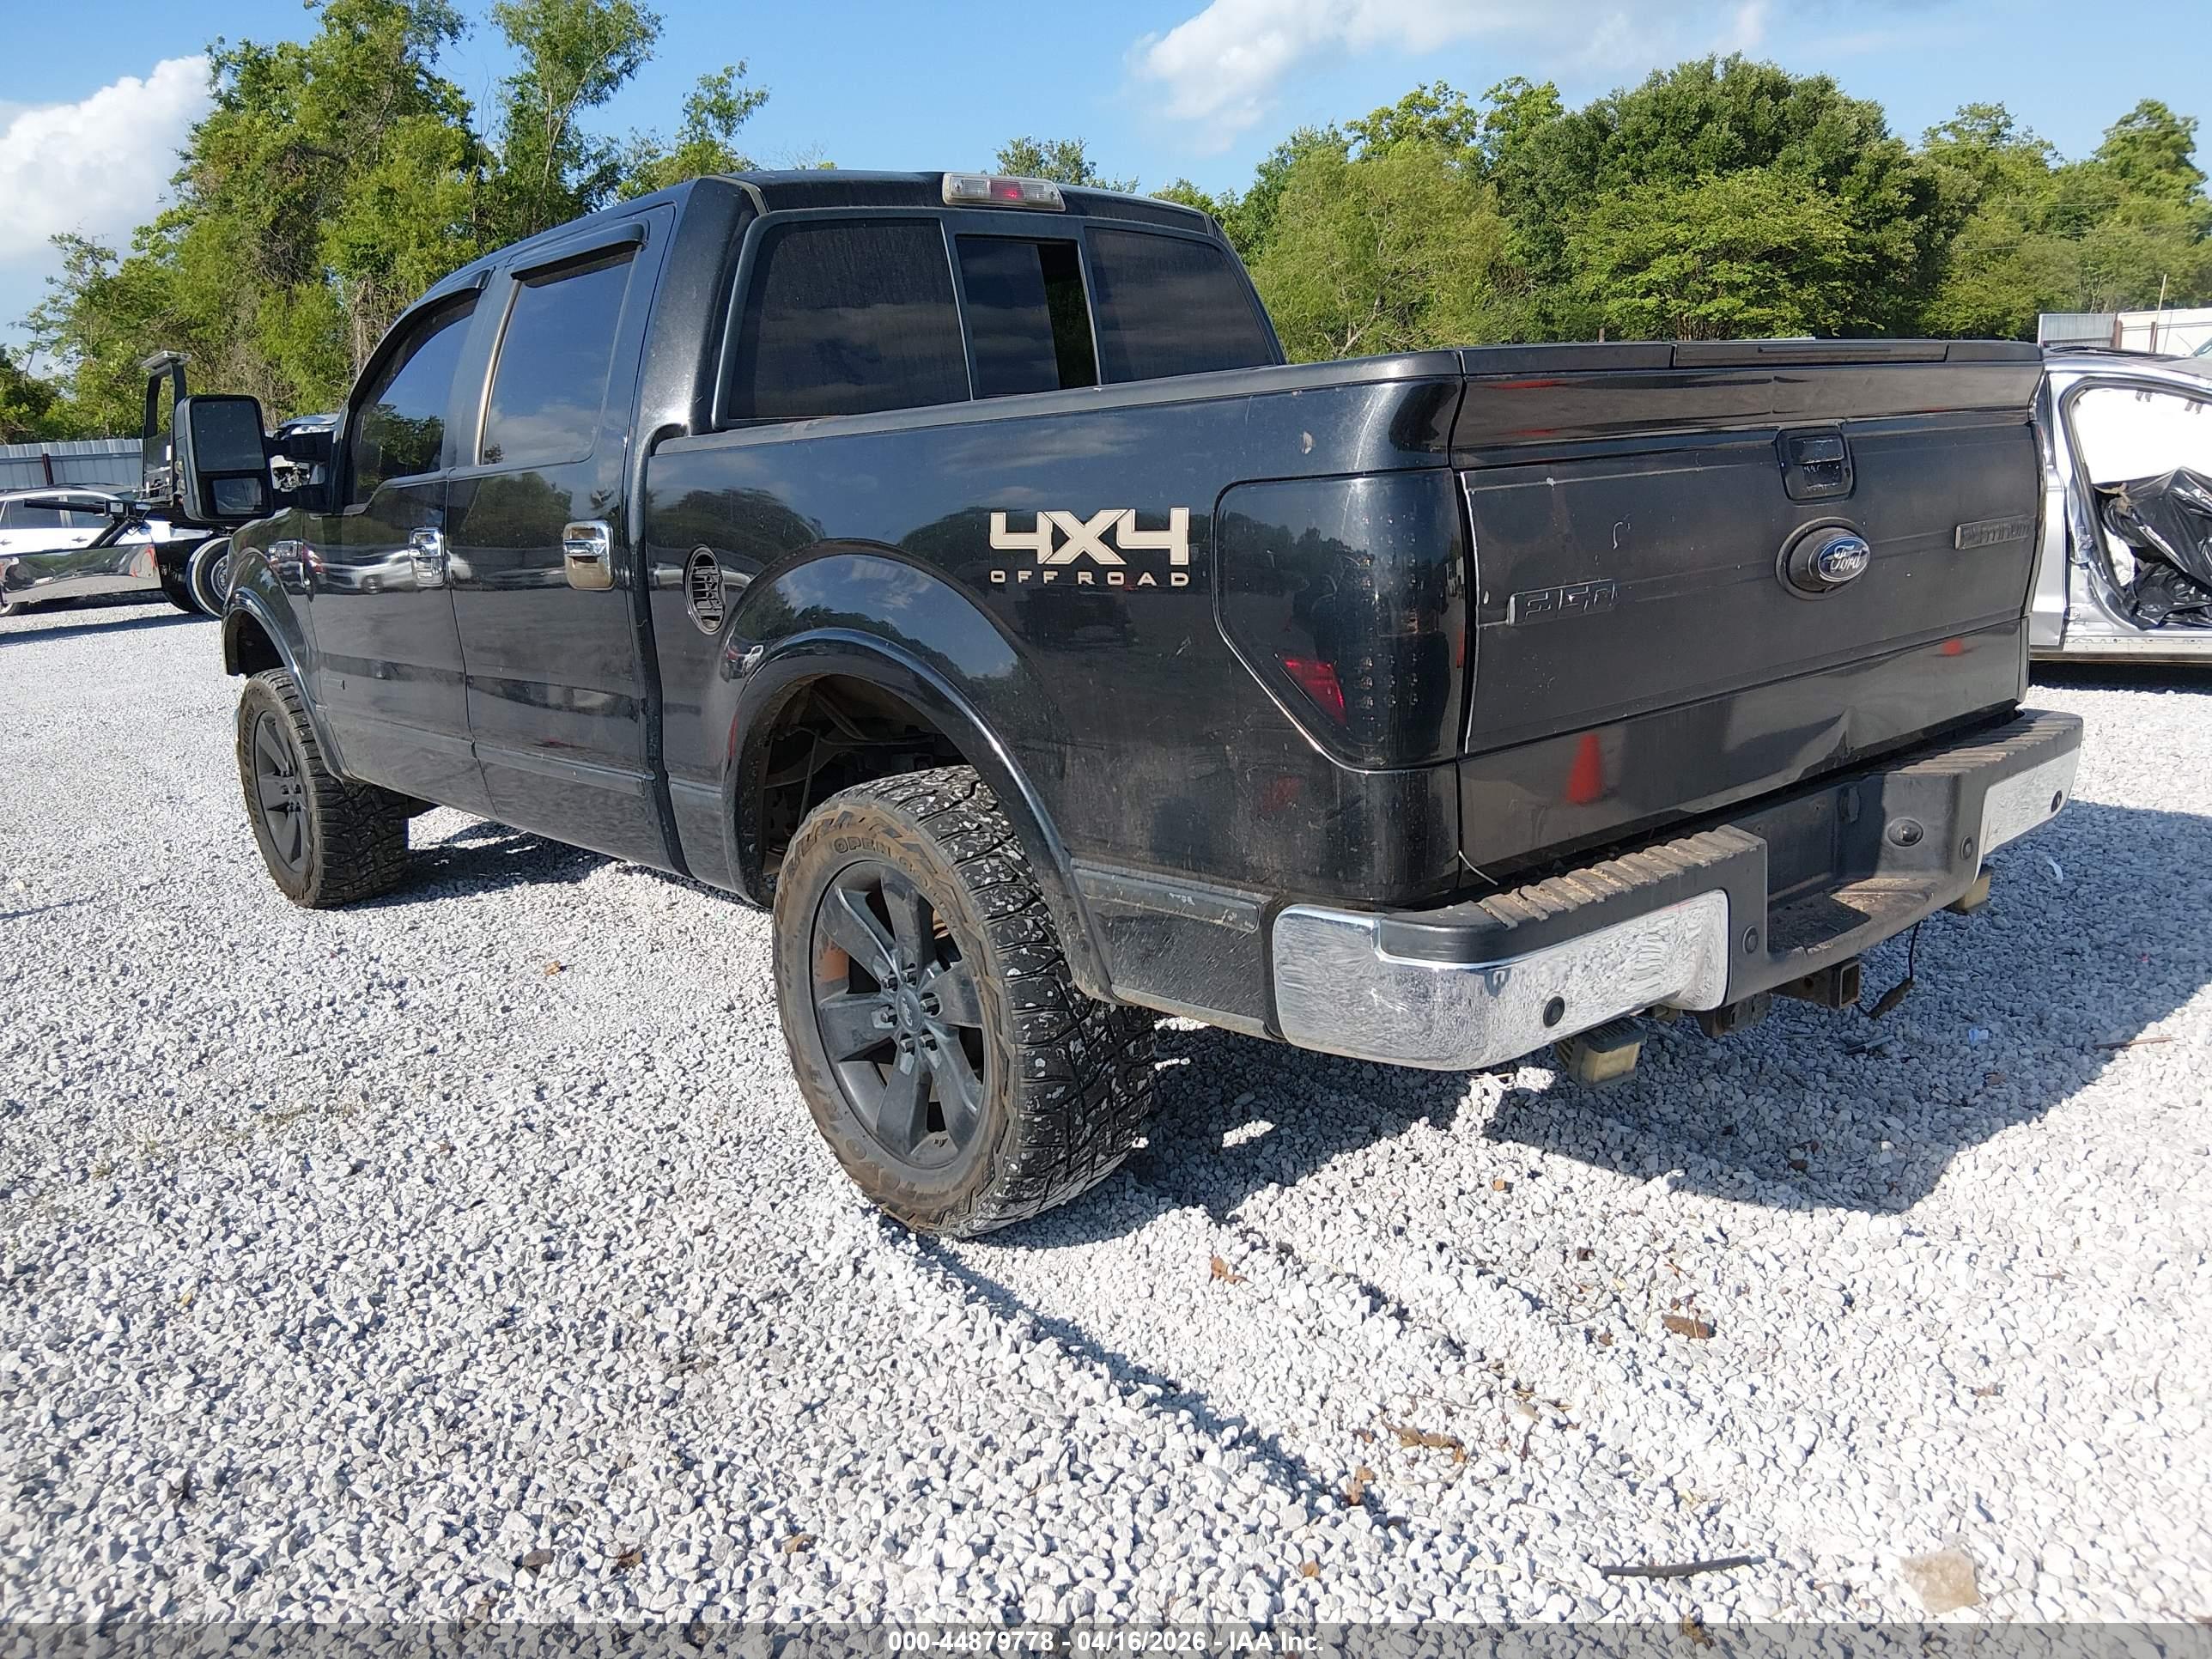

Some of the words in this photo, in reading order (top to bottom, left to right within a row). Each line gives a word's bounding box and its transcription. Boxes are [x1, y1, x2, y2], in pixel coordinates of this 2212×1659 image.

[990, 507, 1189, 566] 4X4
[1825, 544, 1865, 574] Ford
[990, 569, 1059, 584] OFF
[1077, 571, 1189, 586] ROAD
